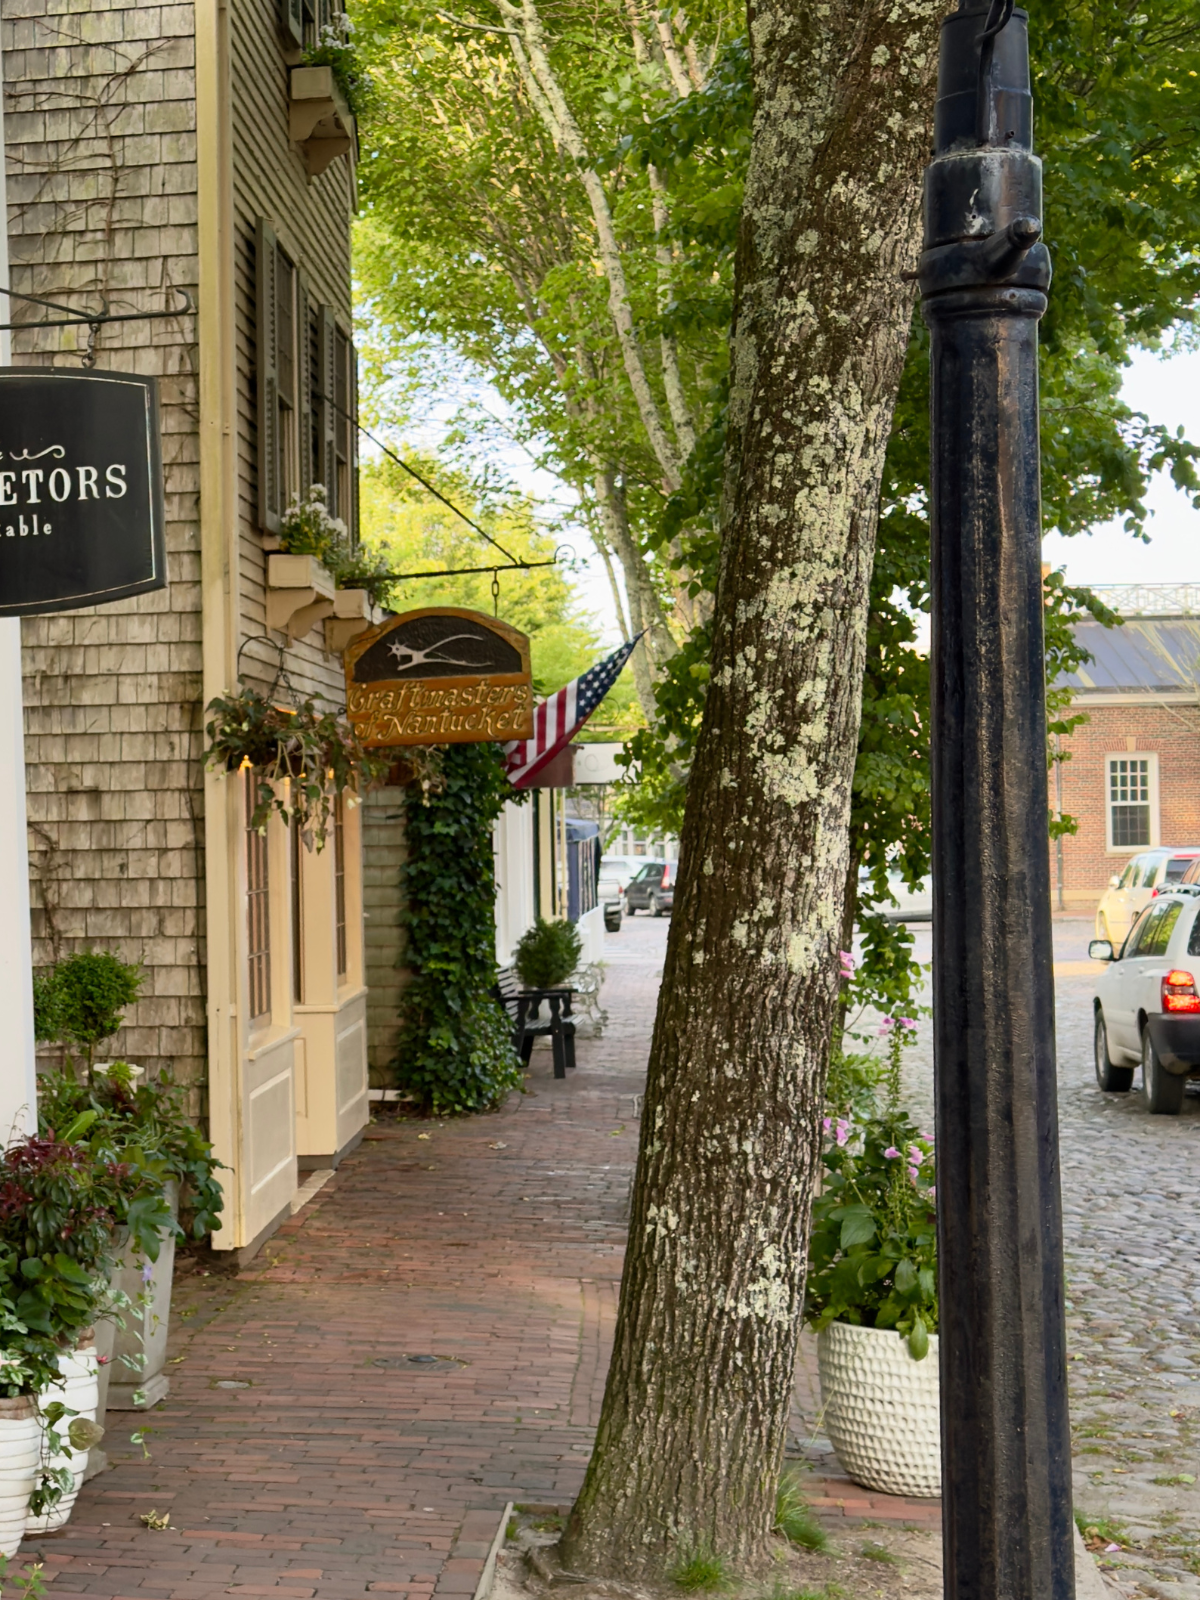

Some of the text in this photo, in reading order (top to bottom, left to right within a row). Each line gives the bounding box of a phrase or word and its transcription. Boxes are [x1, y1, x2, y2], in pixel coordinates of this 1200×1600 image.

[349, 680, 528, 712] Craftmasters
[354, 704, 526, 739] of Nantucket
